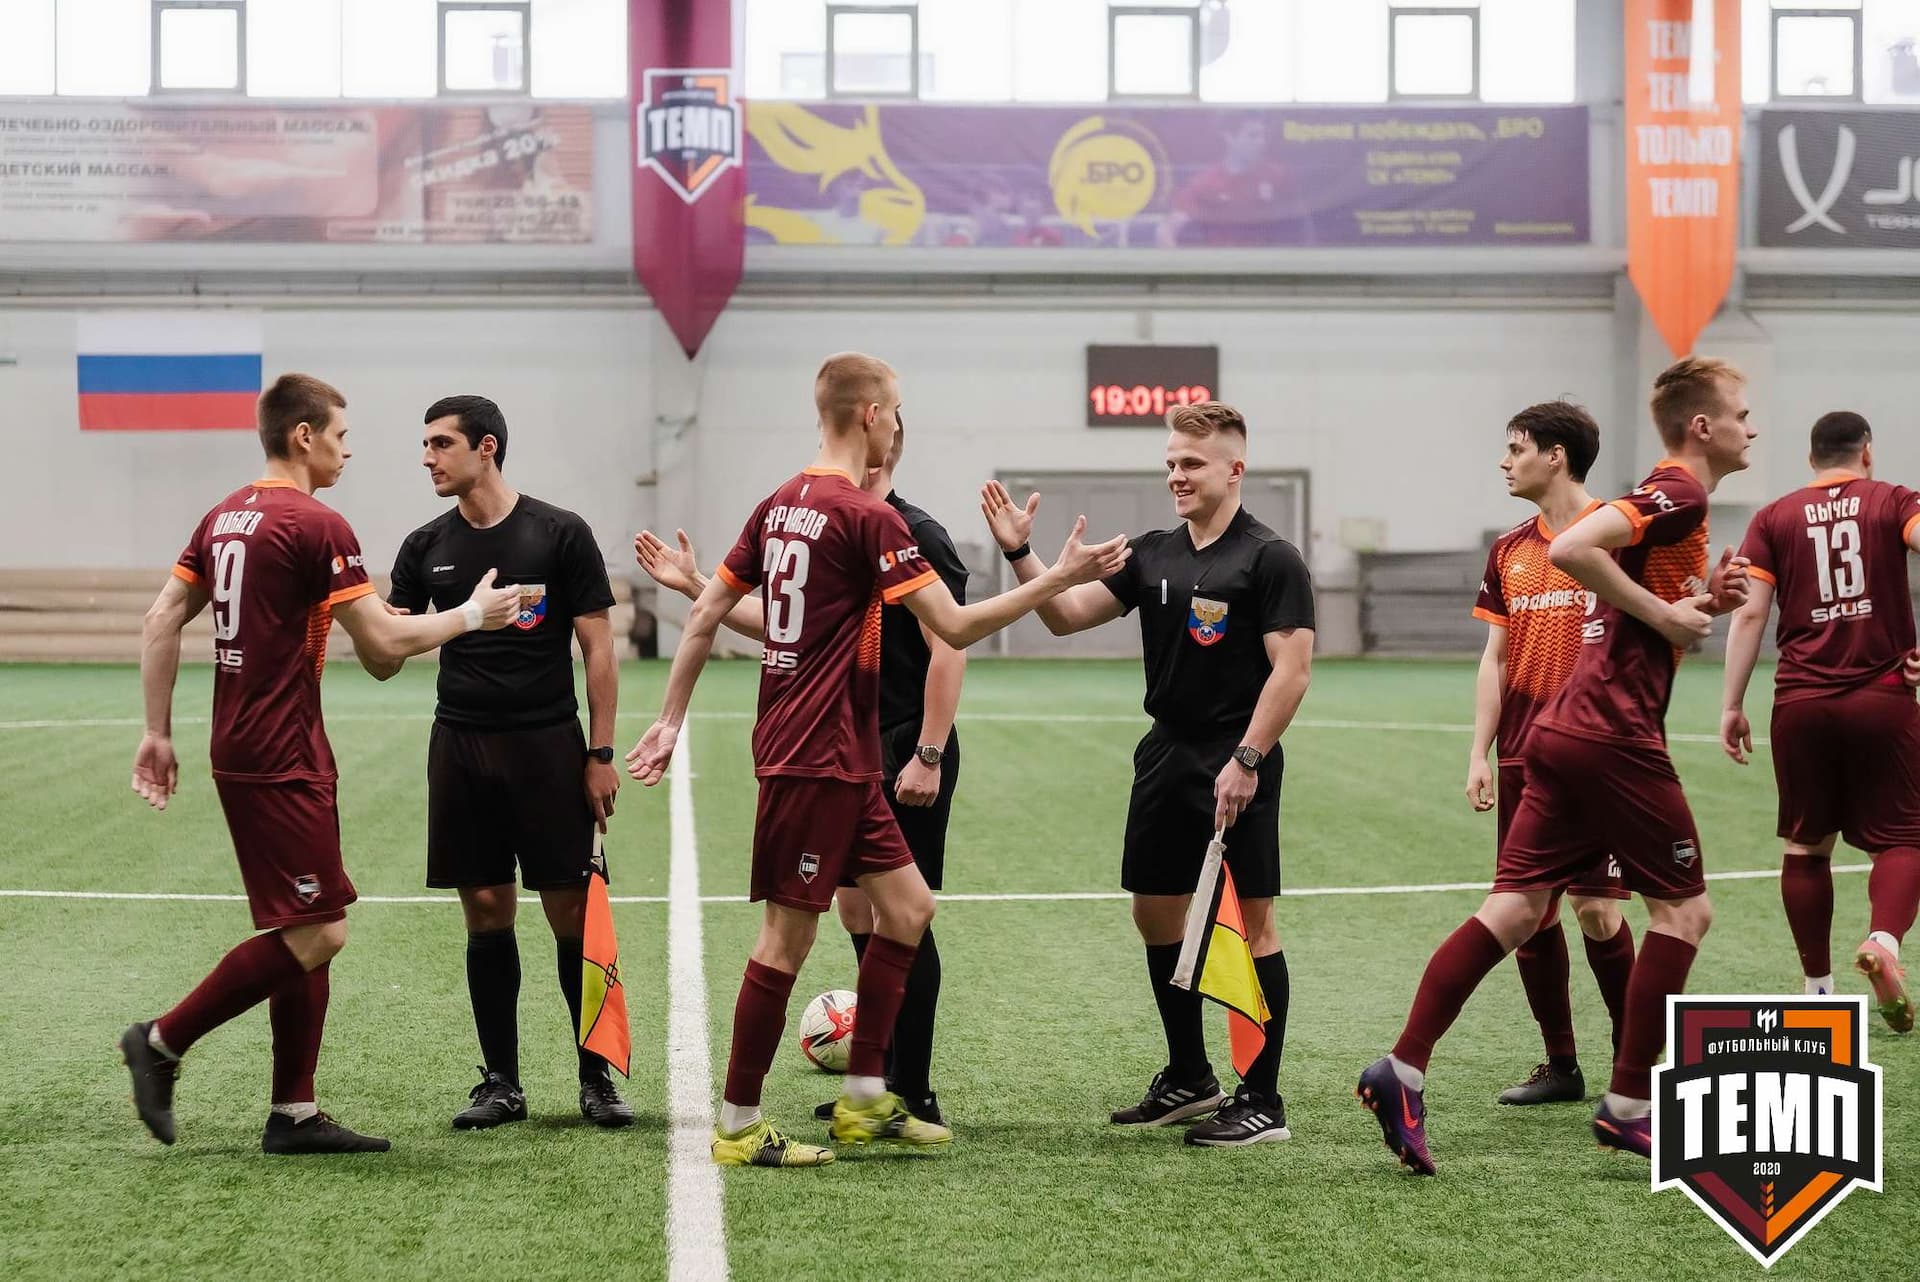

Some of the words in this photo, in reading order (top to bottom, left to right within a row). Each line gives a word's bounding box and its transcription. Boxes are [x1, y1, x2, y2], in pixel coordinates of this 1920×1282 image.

[648, 106, 733, 153] ТЕМП
[1637, 126, 1732, 166] ТОЛЬКО
[1805, 496, 1861, 524] СЫЧЕВ
[1807, 519, 1866, 603] 13
[212, 540, 246, 641] 19
